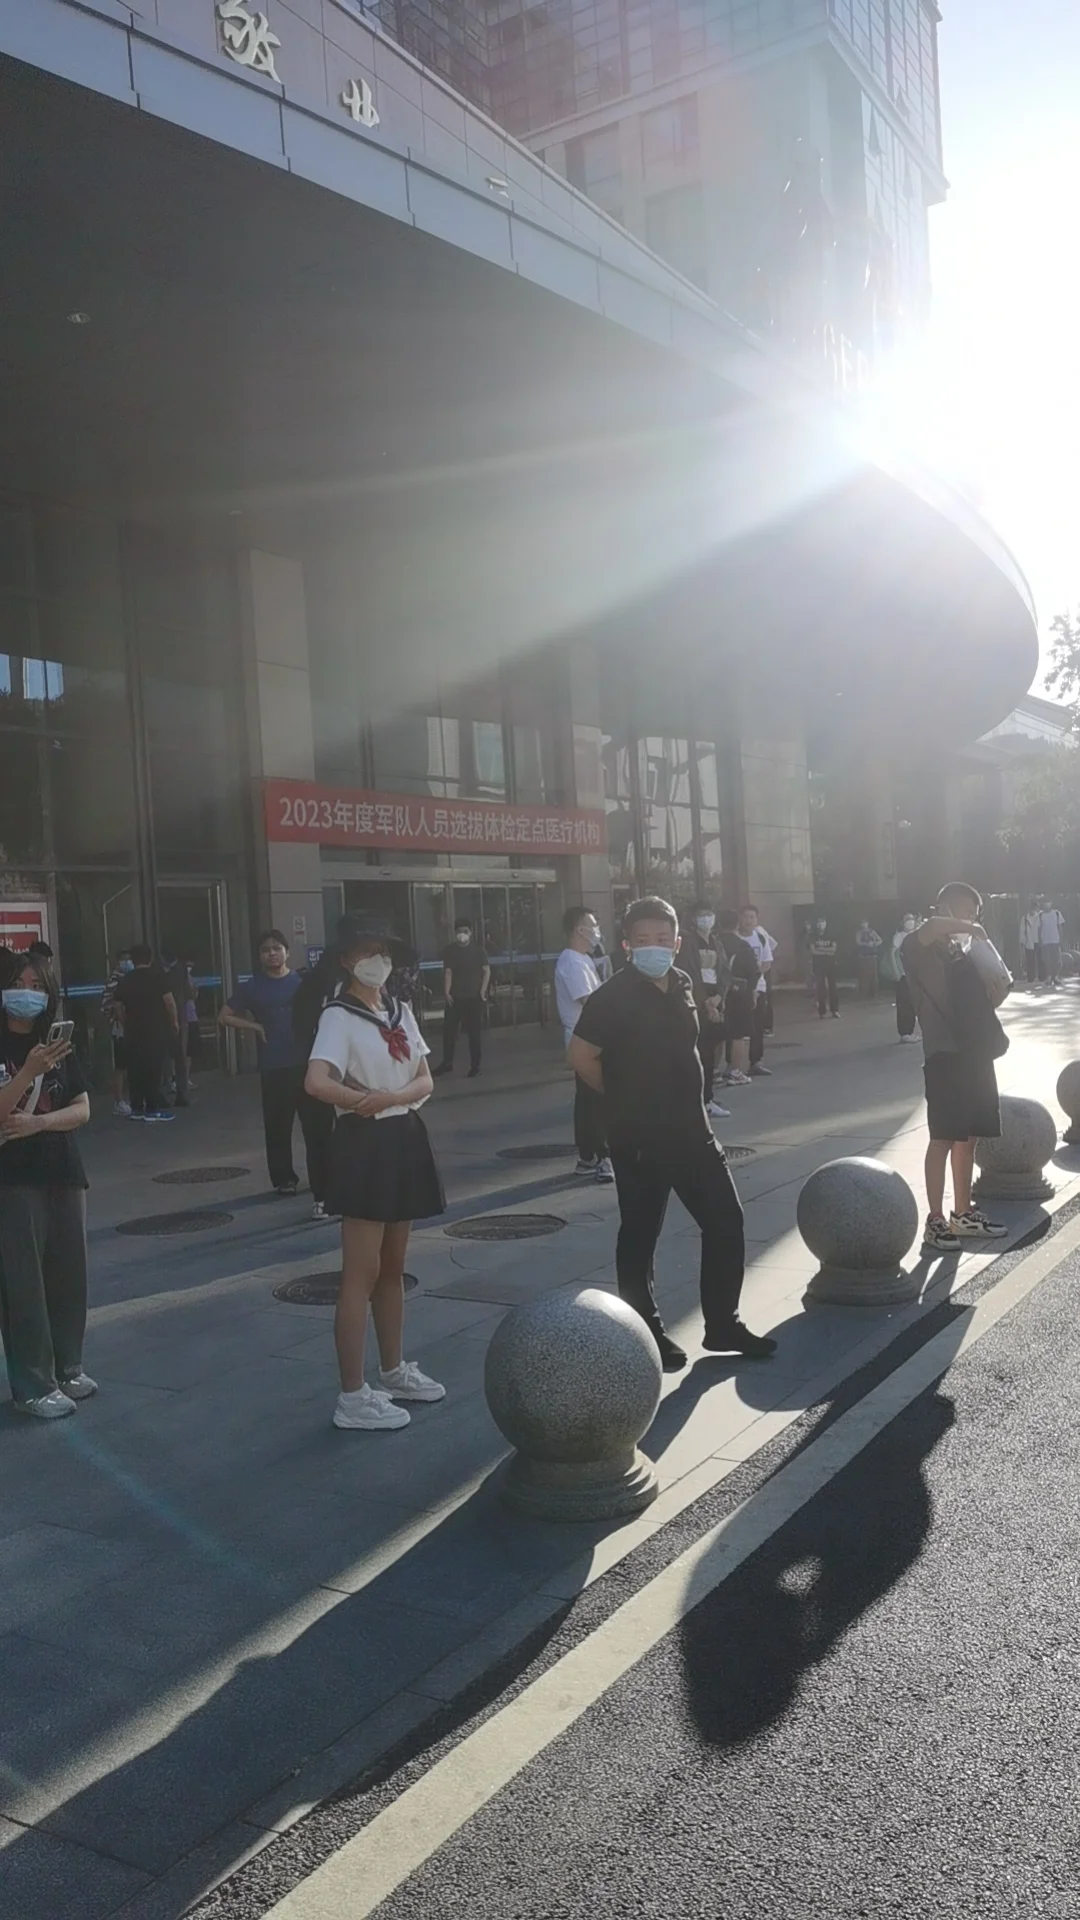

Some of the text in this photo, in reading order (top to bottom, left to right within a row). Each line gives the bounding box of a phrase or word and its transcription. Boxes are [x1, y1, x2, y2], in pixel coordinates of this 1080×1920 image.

[279, 797, 600, 846] 2023年度军队人员选拔体检定点医疗机构
